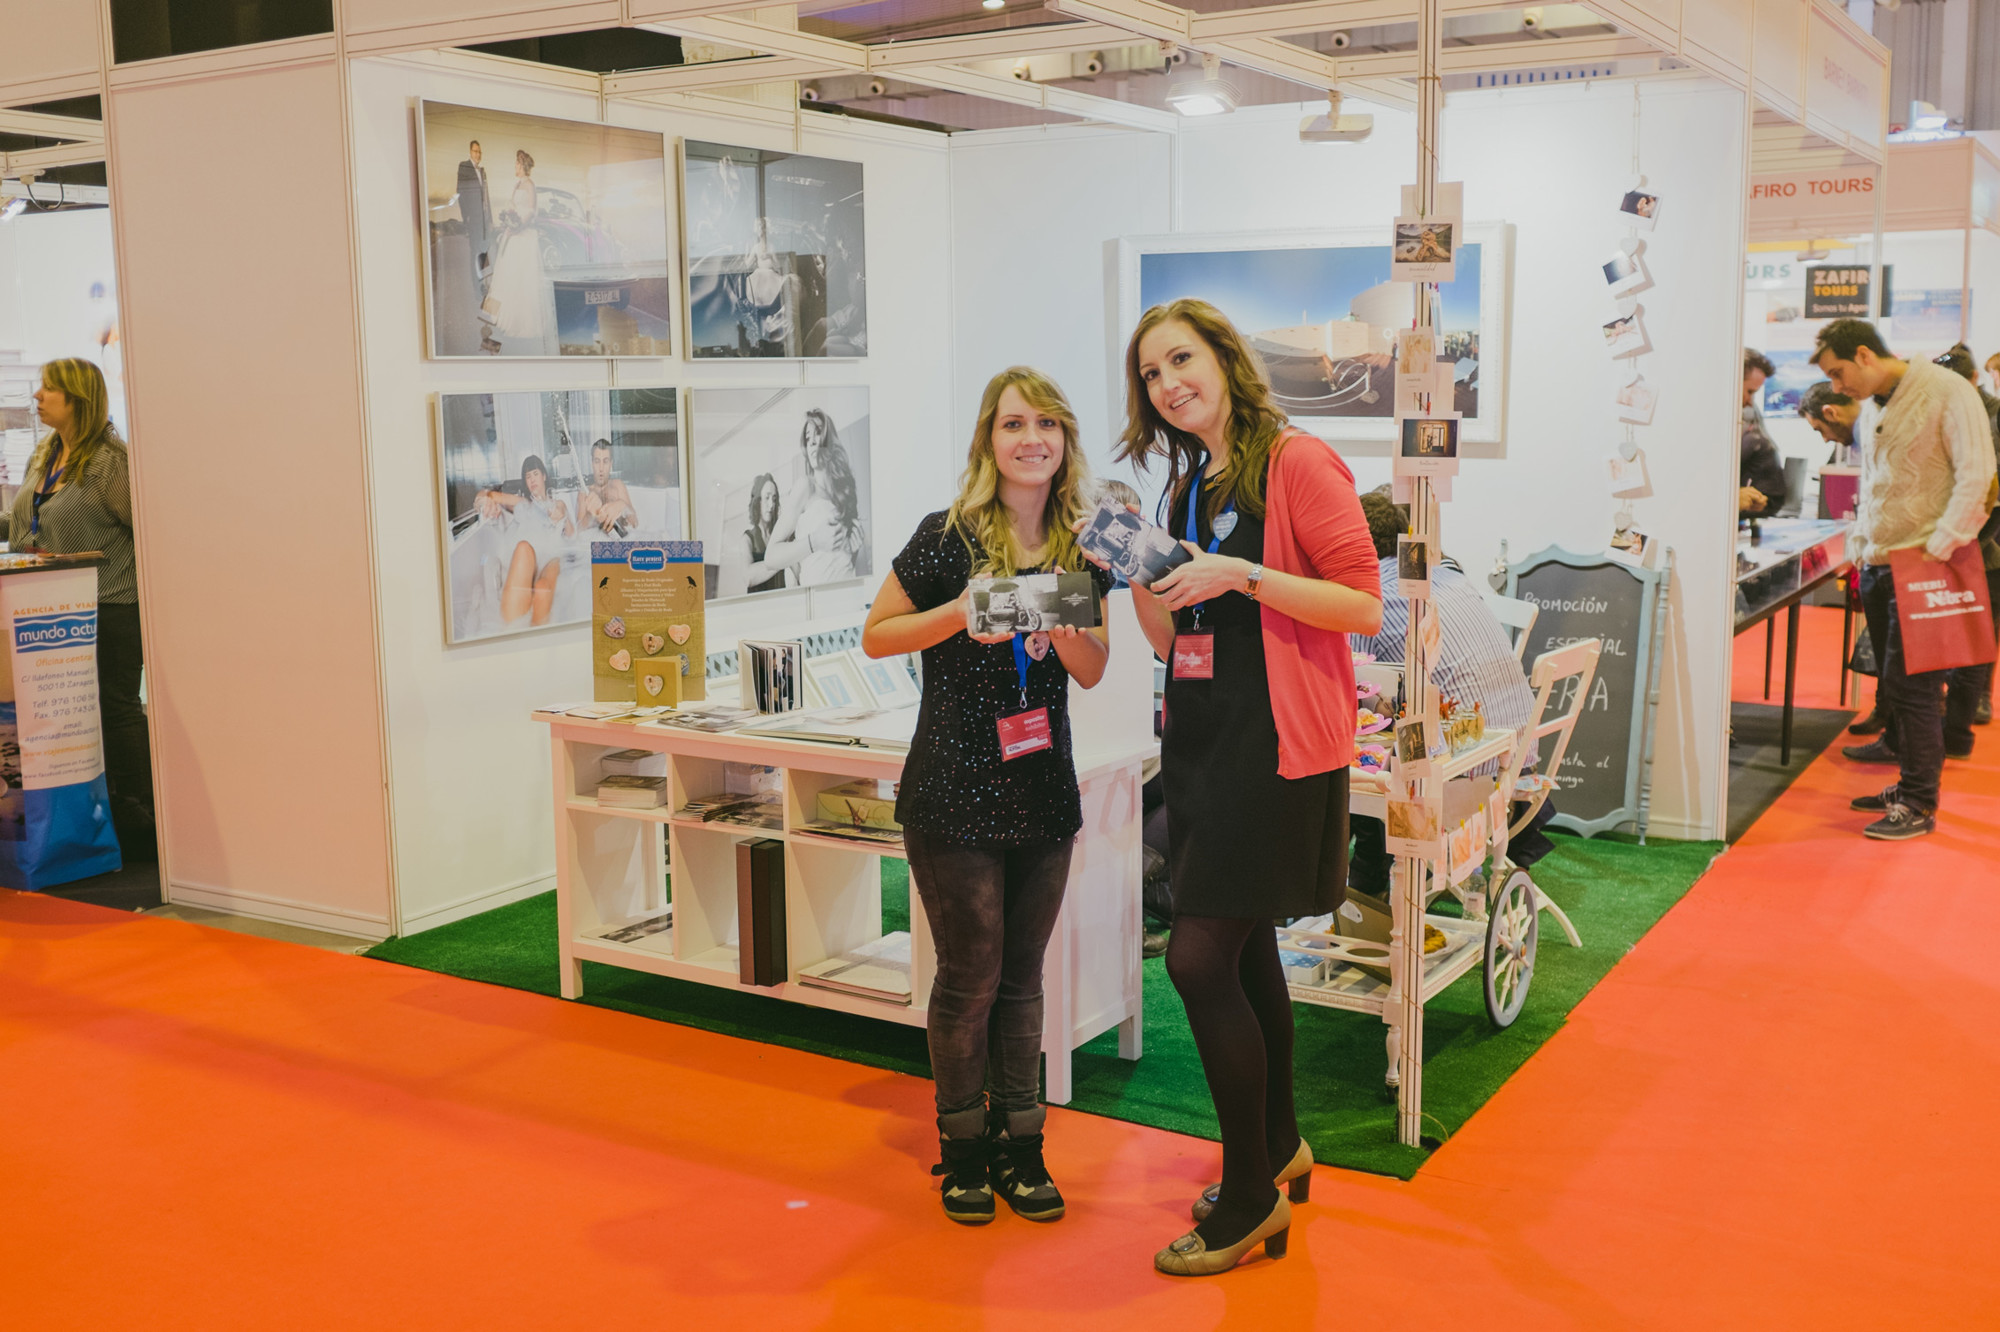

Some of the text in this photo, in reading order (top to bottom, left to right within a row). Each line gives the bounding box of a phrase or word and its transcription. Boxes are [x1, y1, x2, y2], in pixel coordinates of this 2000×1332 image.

[1750, 177, 1874, 199] FIRO TOURS
[1813, 284, 1859, 297] TOURS
[1925, 590, 1976, 608] Nira
[13, 606, 54, 616] AGENCIA
[19, 623, 97, 642] mundo actu
[35, 658, 64, 668] Oficina
[53, 707, 71, 718] 976
